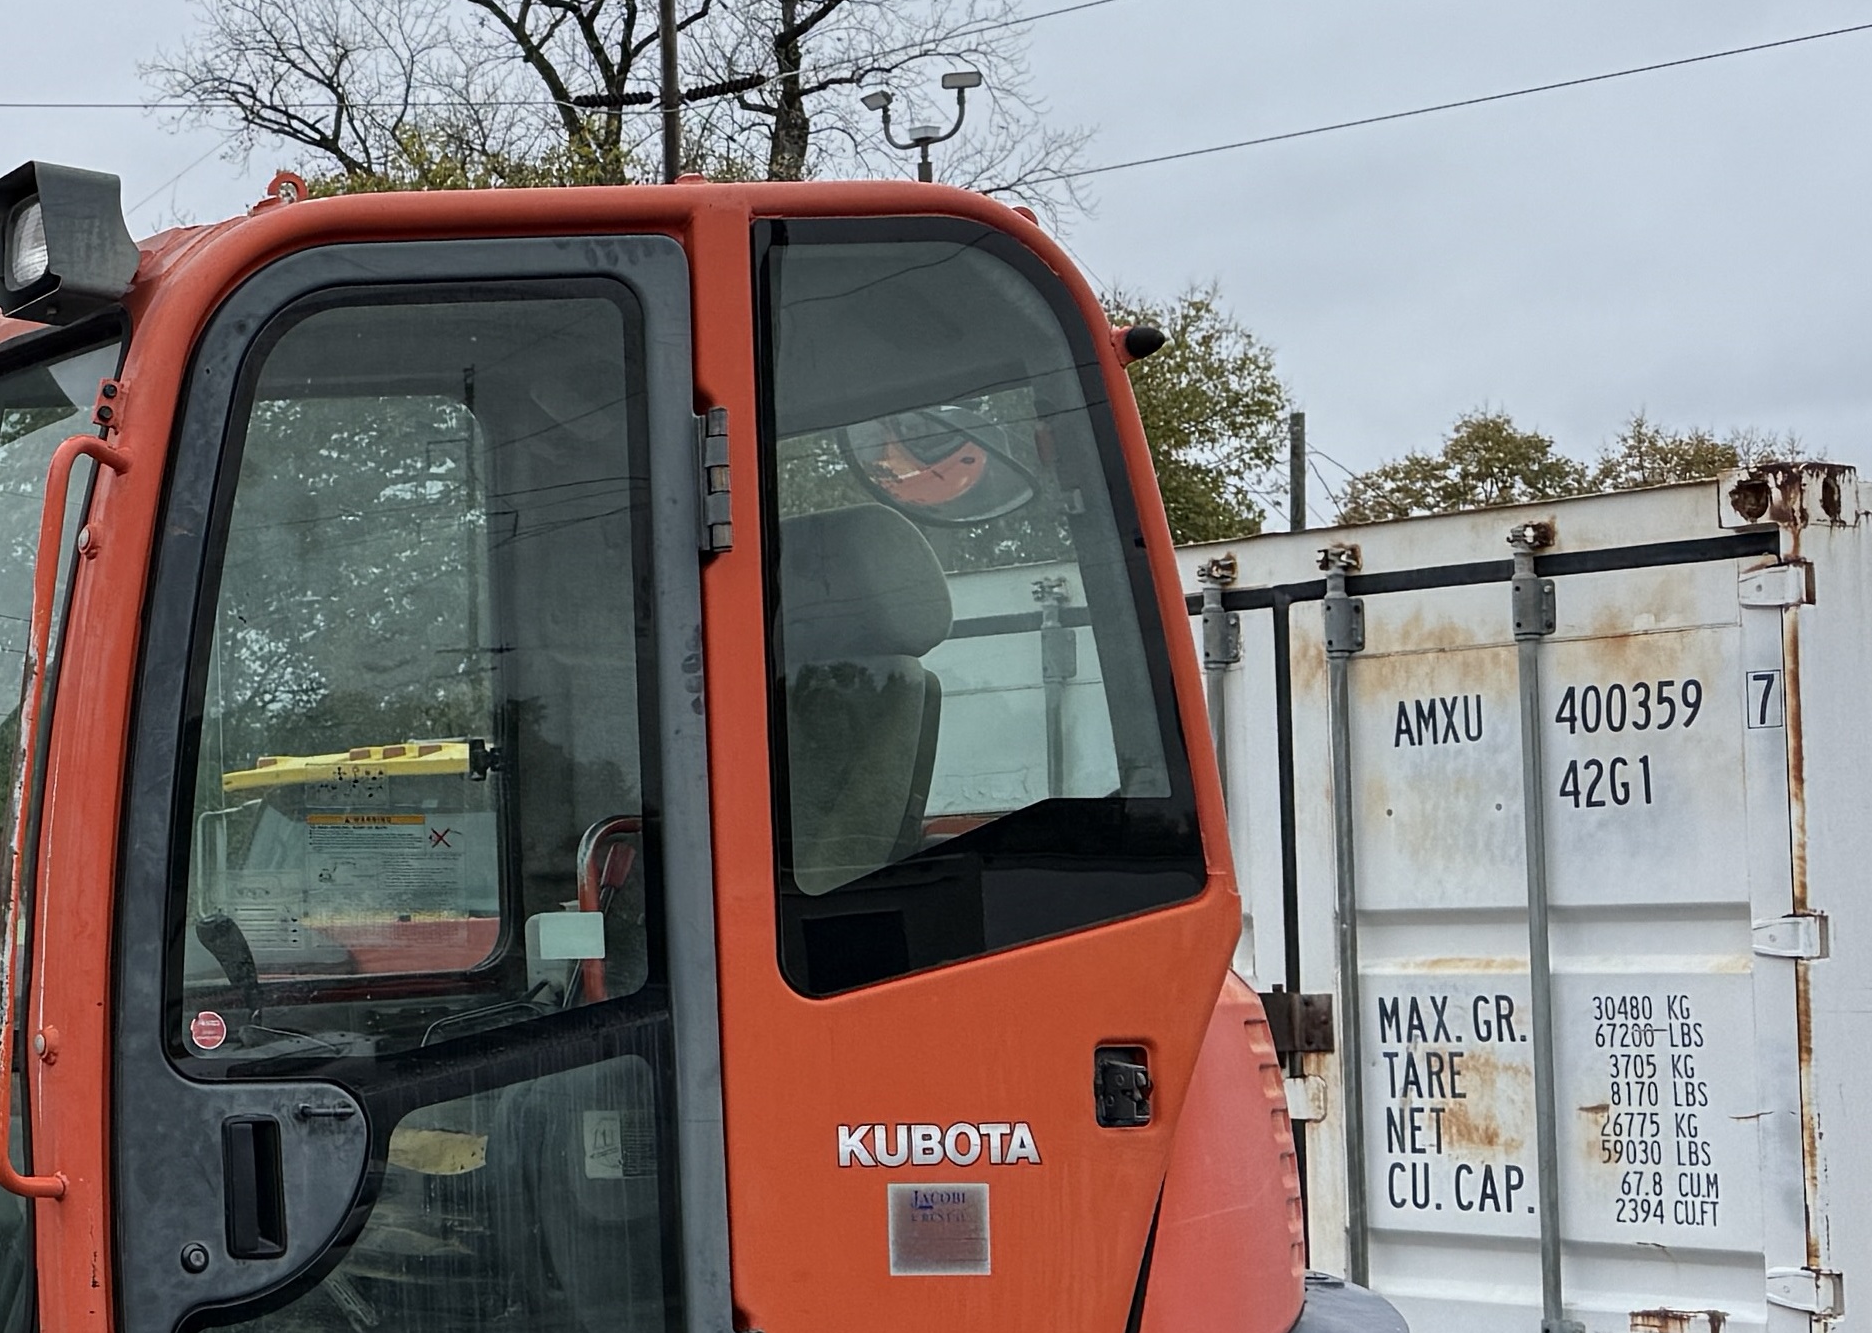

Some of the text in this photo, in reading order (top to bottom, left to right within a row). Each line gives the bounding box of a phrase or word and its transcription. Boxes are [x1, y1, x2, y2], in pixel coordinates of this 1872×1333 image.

[1394, 673, 1776, 747] AMXU 400359 7
[1559, 755, 1653, 808] 42G1
[1378, 994, 1527, 1043] MAX. GR.
[1592, 994, 1691, 1020] 30480 KG
[1595, 1022, 1705, 1048] 67200 LBS
[1382, 1051, 1467, 1099] TARE
[1609, 1054, 1695, 1079] 3705 KG
[1610, 1081, 1709, 1107] 8170 LBS
[1386, 1106, 1446, 1155] NET
[1600, 1113, 1699, 1139] 26775 KG
[837, 1122, 1043, 1167] KUBOTA
[1601, 1140, 1712, 1167] 59030 LBS
[1388, 1162, 1536, 1214] CU. CAP.
[1621, 1171, 1720, 1200] 67.8 CU.M
[1616, 1198, 1665, 1225] 2394
